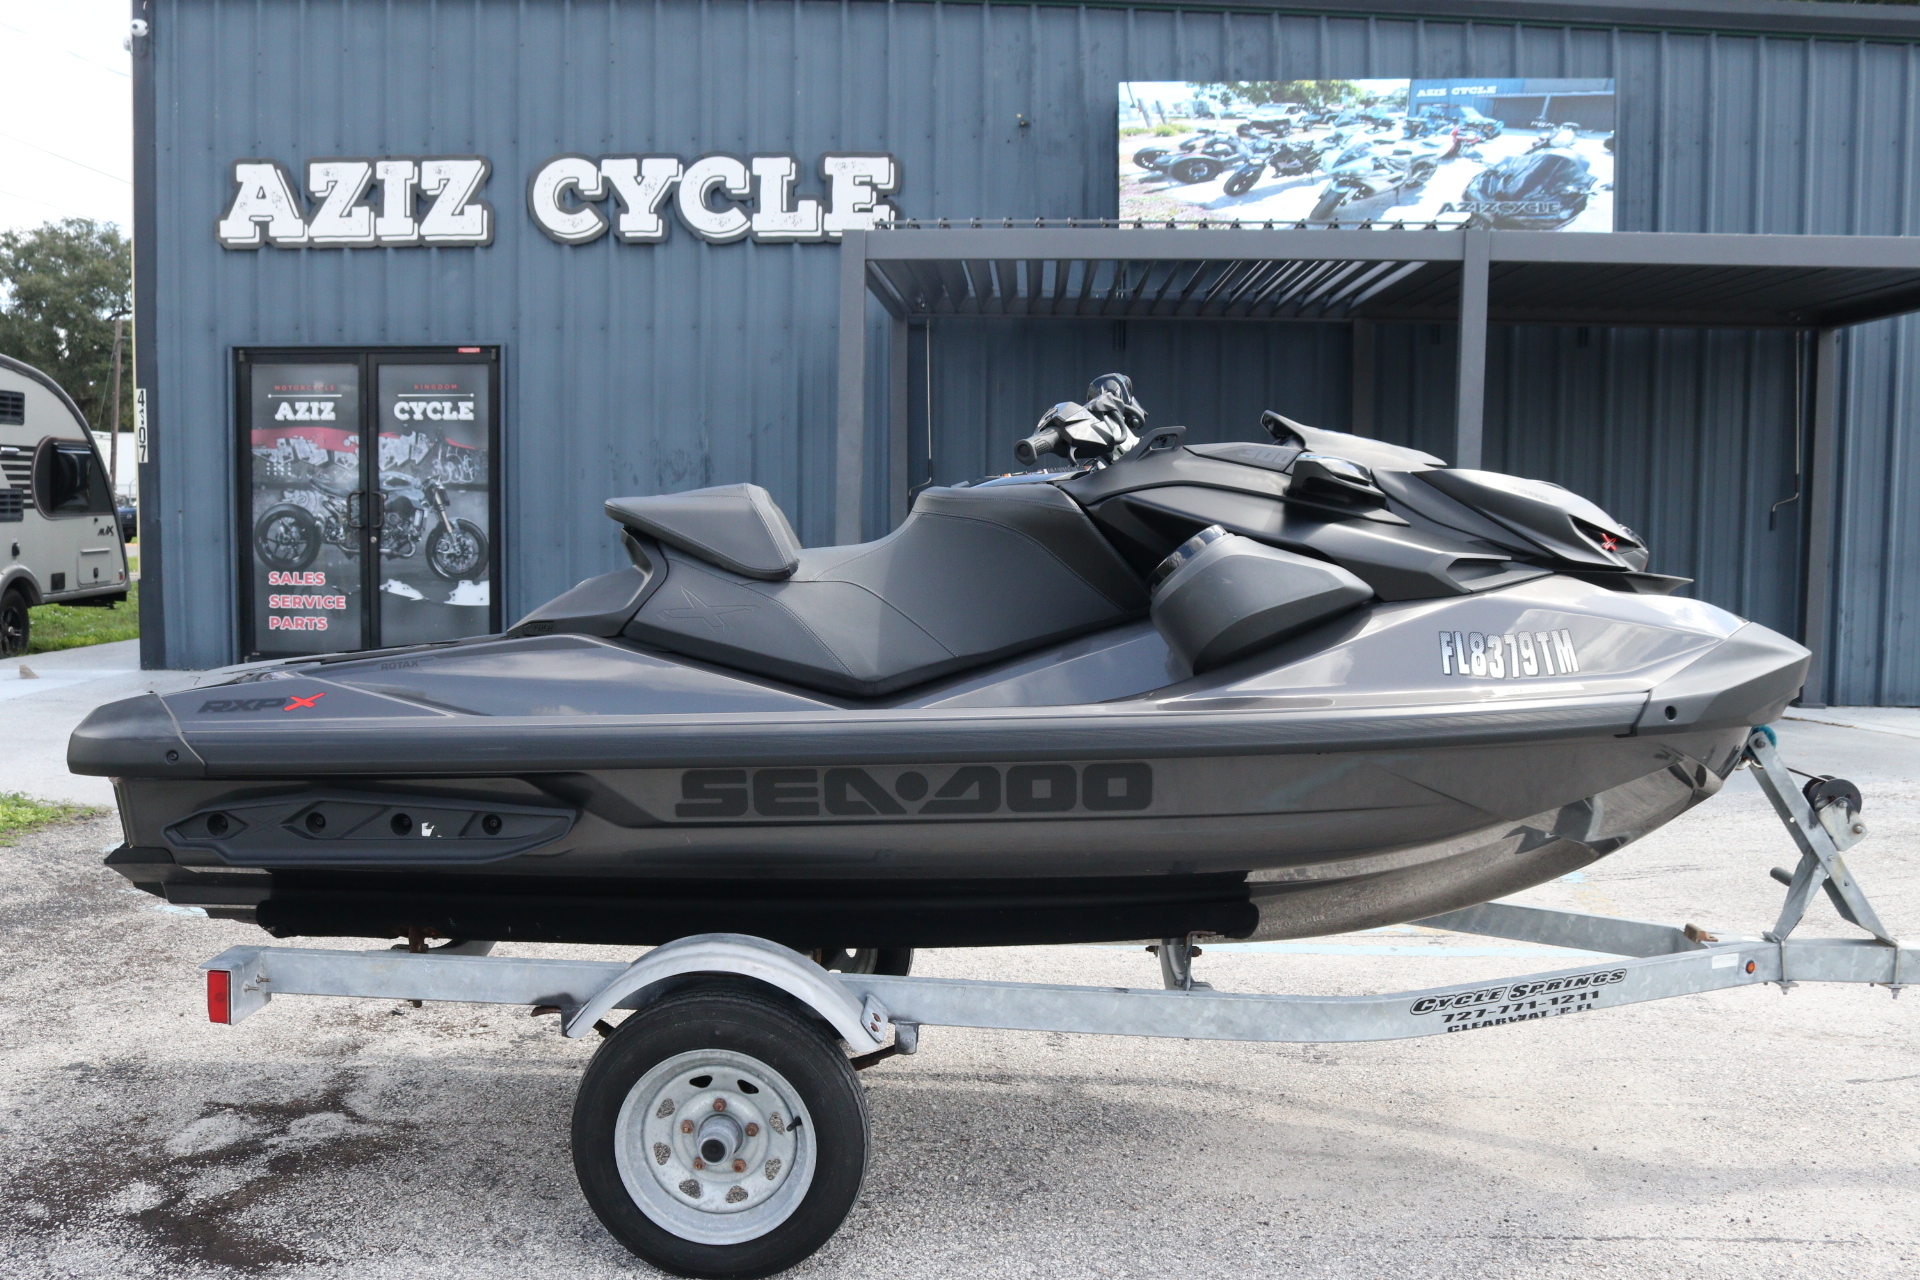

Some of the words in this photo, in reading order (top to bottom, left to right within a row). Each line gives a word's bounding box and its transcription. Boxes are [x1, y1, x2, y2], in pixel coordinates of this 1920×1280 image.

[1416, 88, 1447, 97] AZIZ
[1451, 86, 1497, 95] CYCLE
[219, 159, 485, 243] AZIZ
[533, 156, 896, 238] CYCLE
[274, 401, 336, 420] AZIZ
[393, 401, 475, 420] CYCLE
[268, 571, 326, 586] SALES
[268, 594, 347, 609] SERVICE
[268, 616, 328, 631] PARTS
[534, 624, 553, 632] PUSH
[1438, 628, 1580, 679] FL8379TM
[380, 660, 419, 671] ROTAX
[1442, 991, 1600, 1024] 727-771-1211
[1447, 1006, 1572, 1033] CLEARWATR
